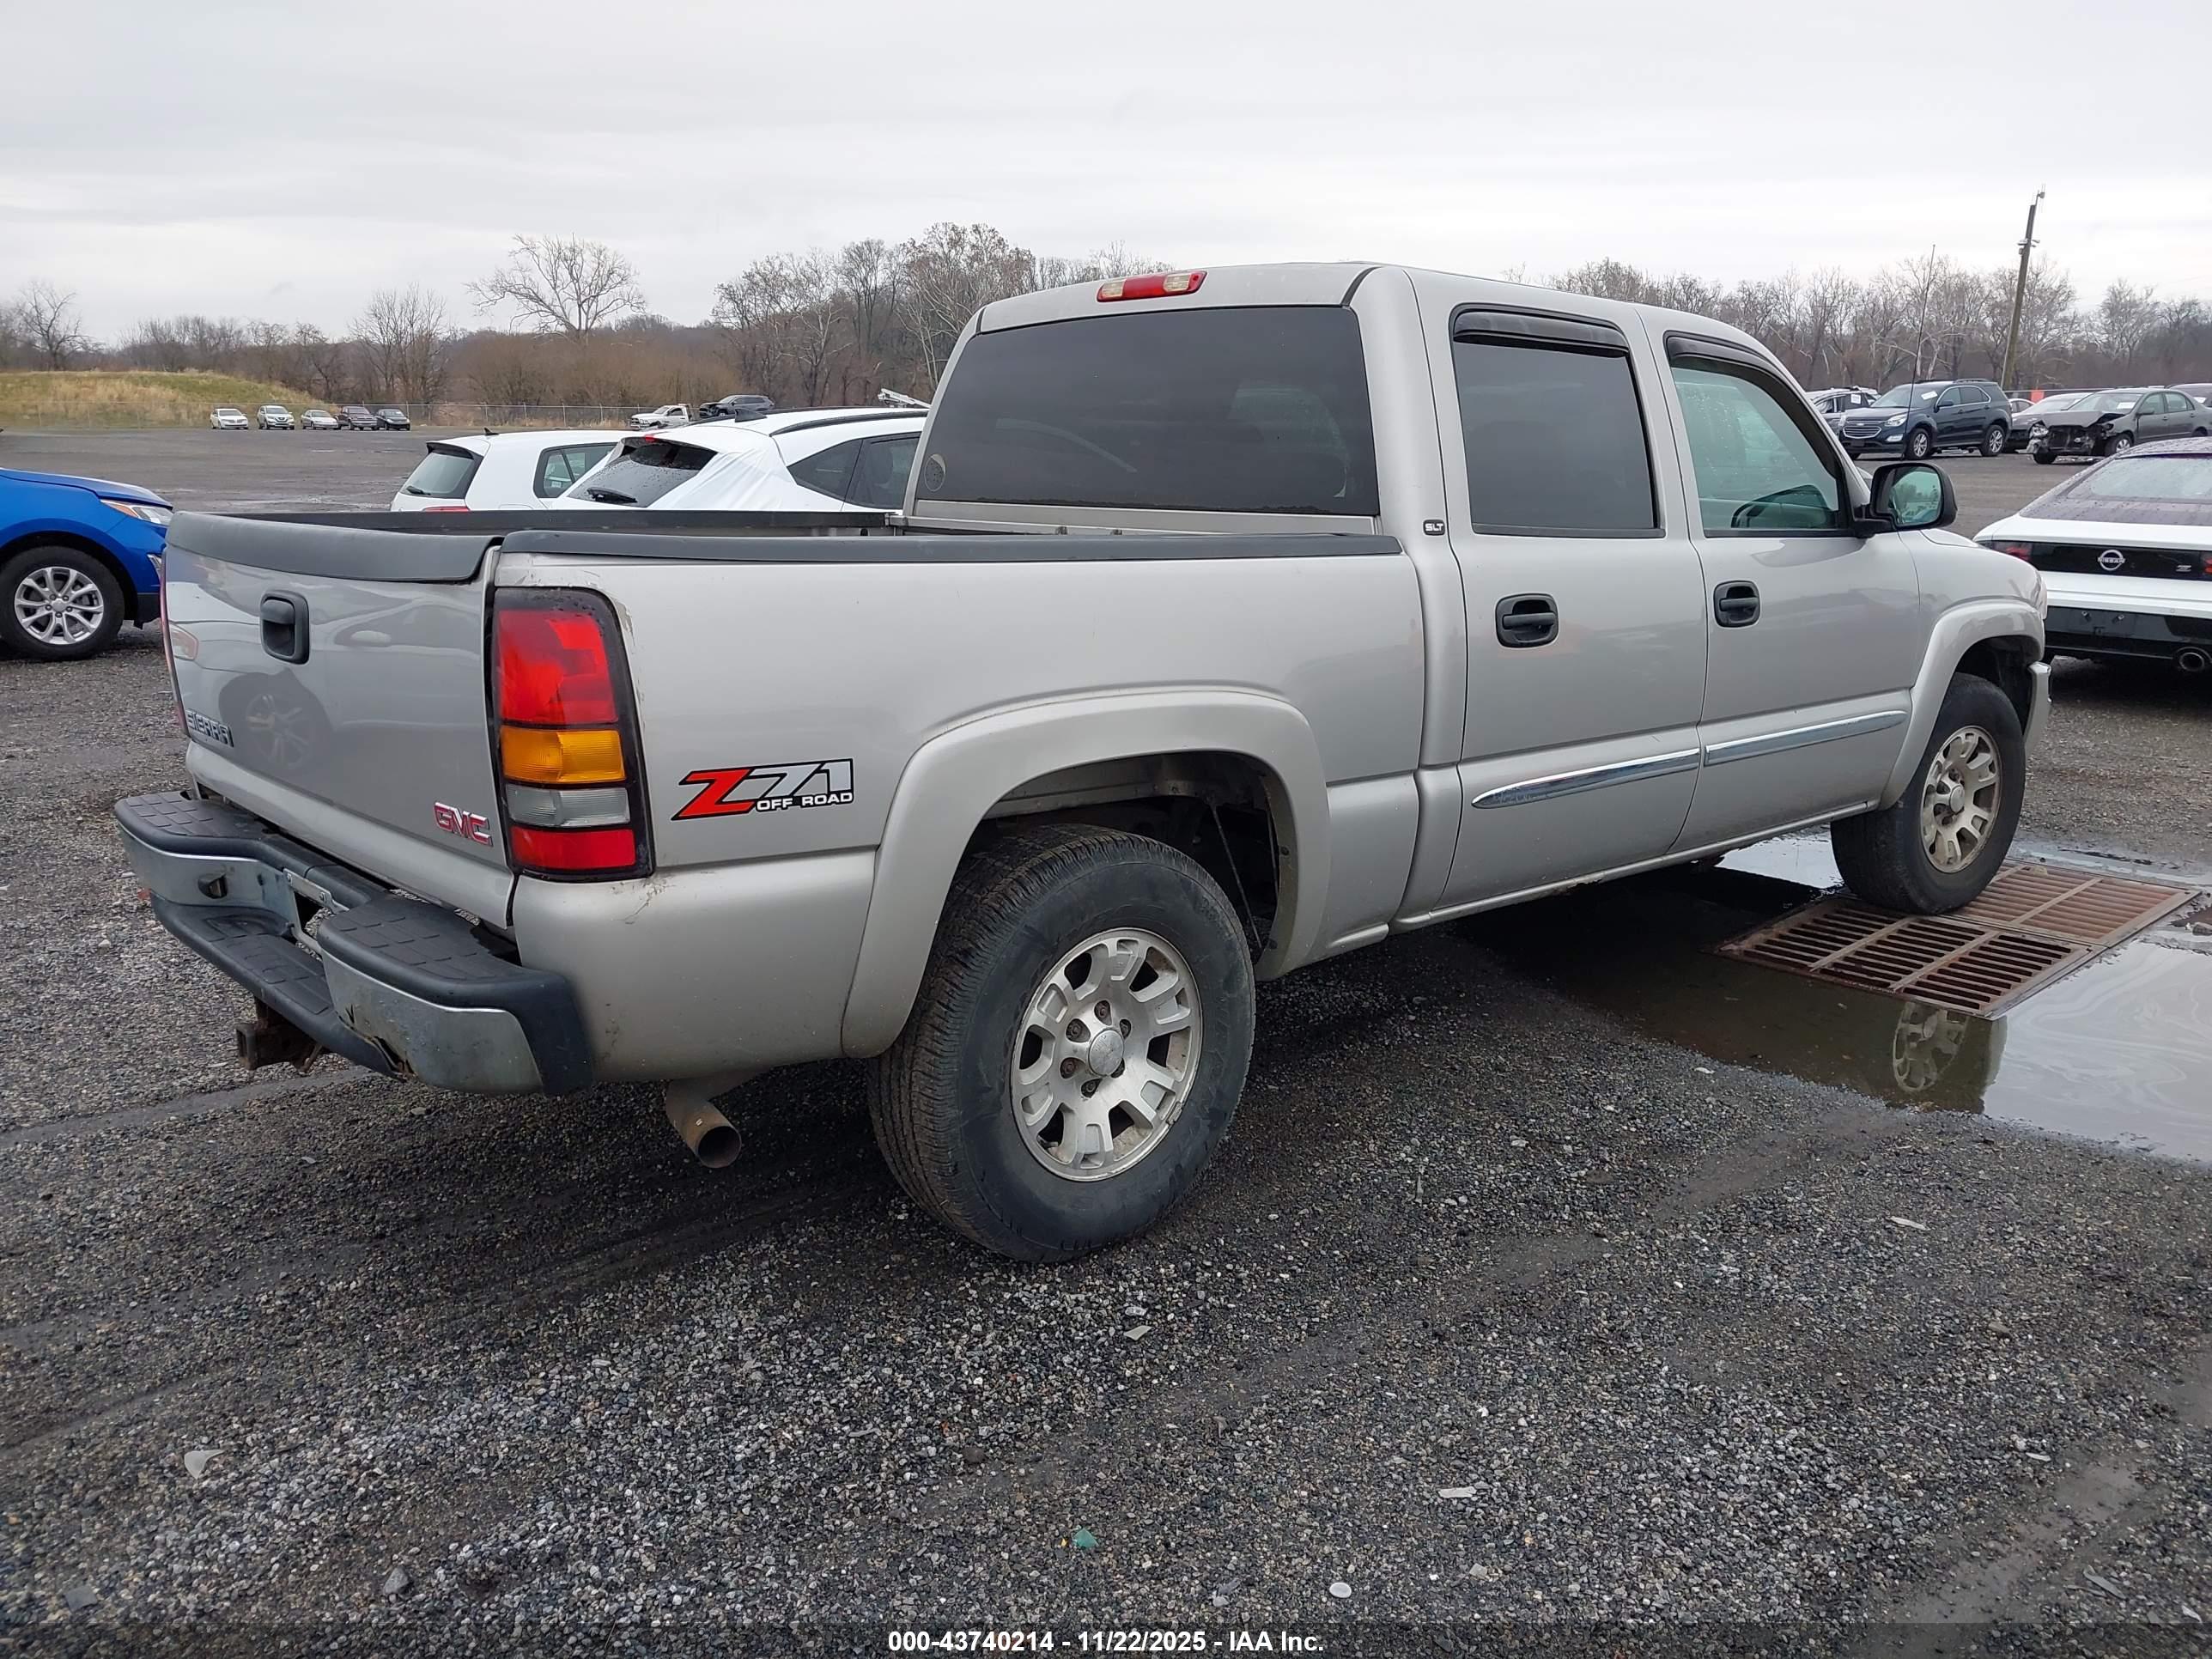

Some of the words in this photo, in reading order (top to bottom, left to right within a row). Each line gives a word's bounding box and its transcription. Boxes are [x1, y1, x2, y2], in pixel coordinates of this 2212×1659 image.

[1425, 523, 1443, 532] SLT
[185, 709, 234, 747] SIERRA
[671, 759, 854, 820] Z71
[757, 798, 793, 811] OFF
[801, 792, 854, 807] ROAD
[434, 802, 494, 847] GMC
